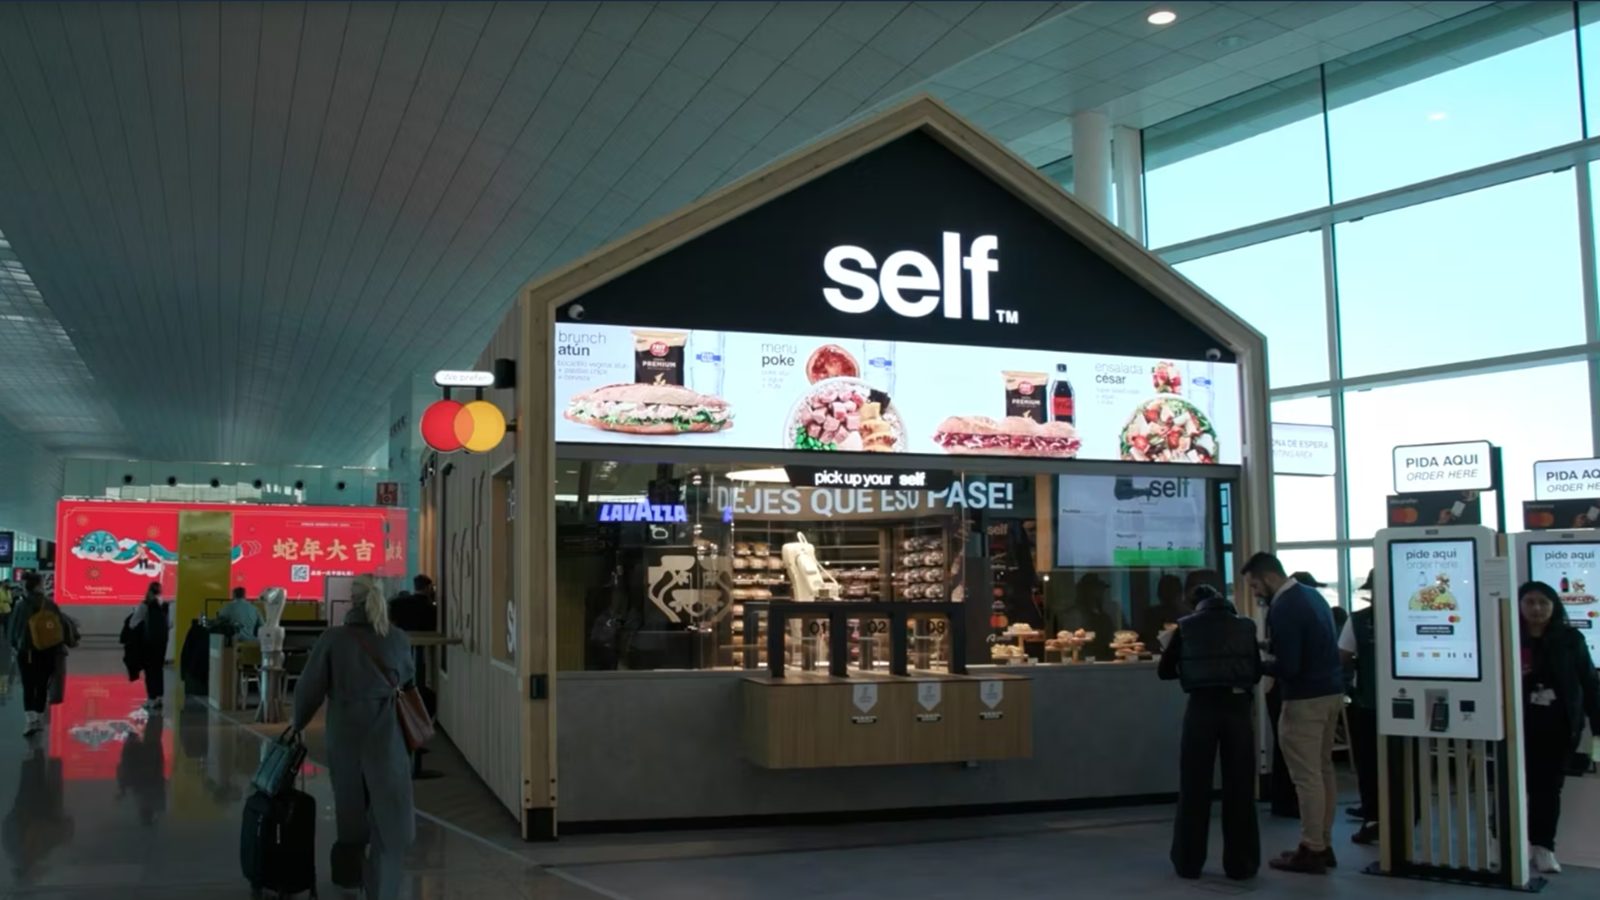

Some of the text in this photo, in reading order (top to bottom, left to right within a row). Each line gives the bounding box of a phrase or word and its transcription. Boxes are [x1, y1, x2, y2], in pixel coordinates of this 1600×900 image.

[822, 231, 1019, 325] self TM
[558, 330, 607, 344] brunch
[558, 343, 591, 356] atún
[761, 343, 797, 354] menu
[642, 360, 676, 368] PREMIUM
[761, 353, 795, 368] poke
[1095, 362, 1143, 375] ensalada
[1095, 372, 1127, 384] césar
[1011, 398, 1041, 406] PREMIUM
[1406, 454, 1479, 469] PIDA AQUI
[814, 470, 927, 487] pick up your self
[1406, 468, 1478, 482] ORDER HERE
[1546, 470, 1578, 481] PIDA
[1149, 476, 1191, 498] self
[1546, 483, 1584, 493] ORDER
[717, 485, 801, 515] DEJES
[810, 488, 874, 517] QUE
[599, 499, 687, 522] LAVAZZA
[272, 537, 376, 562] 蛇年大吉
[1406, 547, 1457, 561] pide aqui
[1544, 549, 1595, 561] pide aqui
[809, 621, 827, 635] 01
[867, 621, 887, 634] 02
[926, 621, 946, 634] 03
